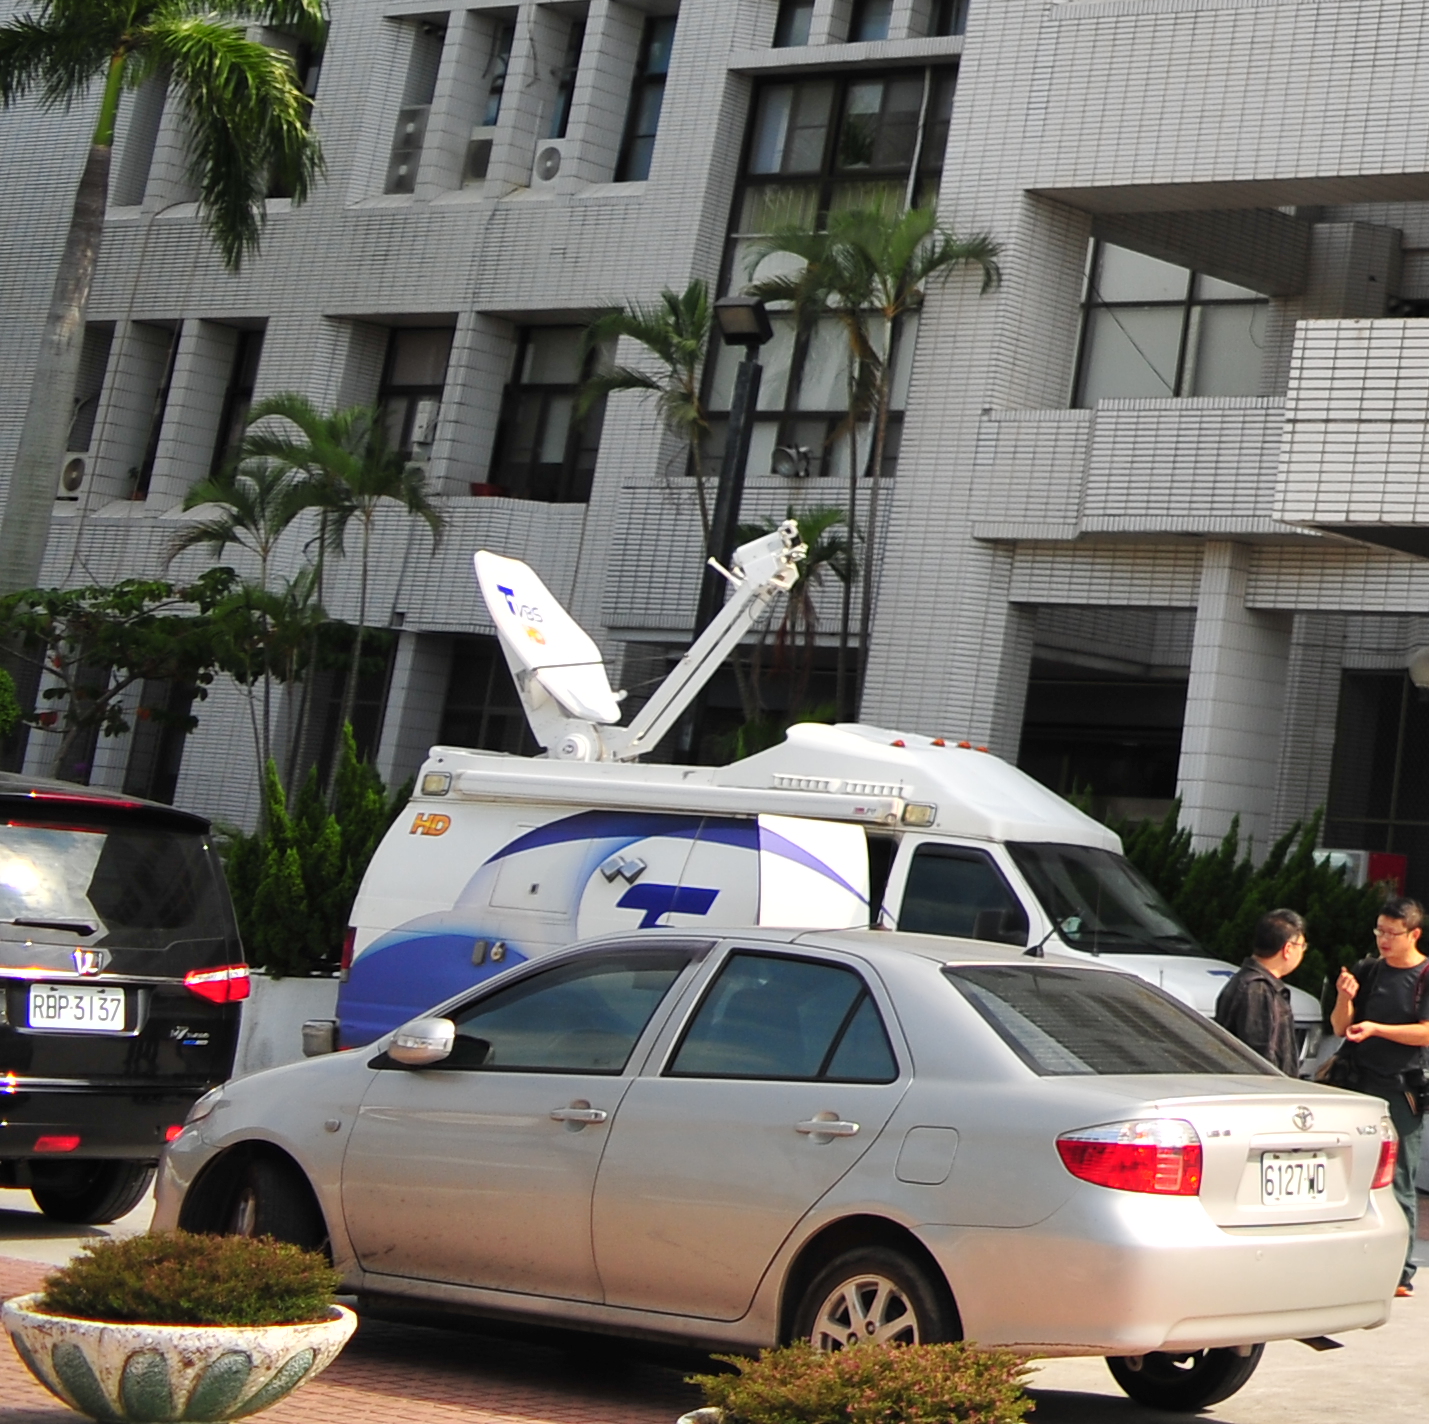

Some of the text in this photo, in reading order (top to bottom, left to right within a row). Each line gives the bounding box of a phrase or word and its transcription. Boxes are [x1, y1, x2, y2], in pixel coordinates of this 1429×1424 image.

[409, 812, 452, 837] HD
[32, 994, 122, 1023] RBP-3137
[1264, 1163, 1326, 1197] 6127-WD
